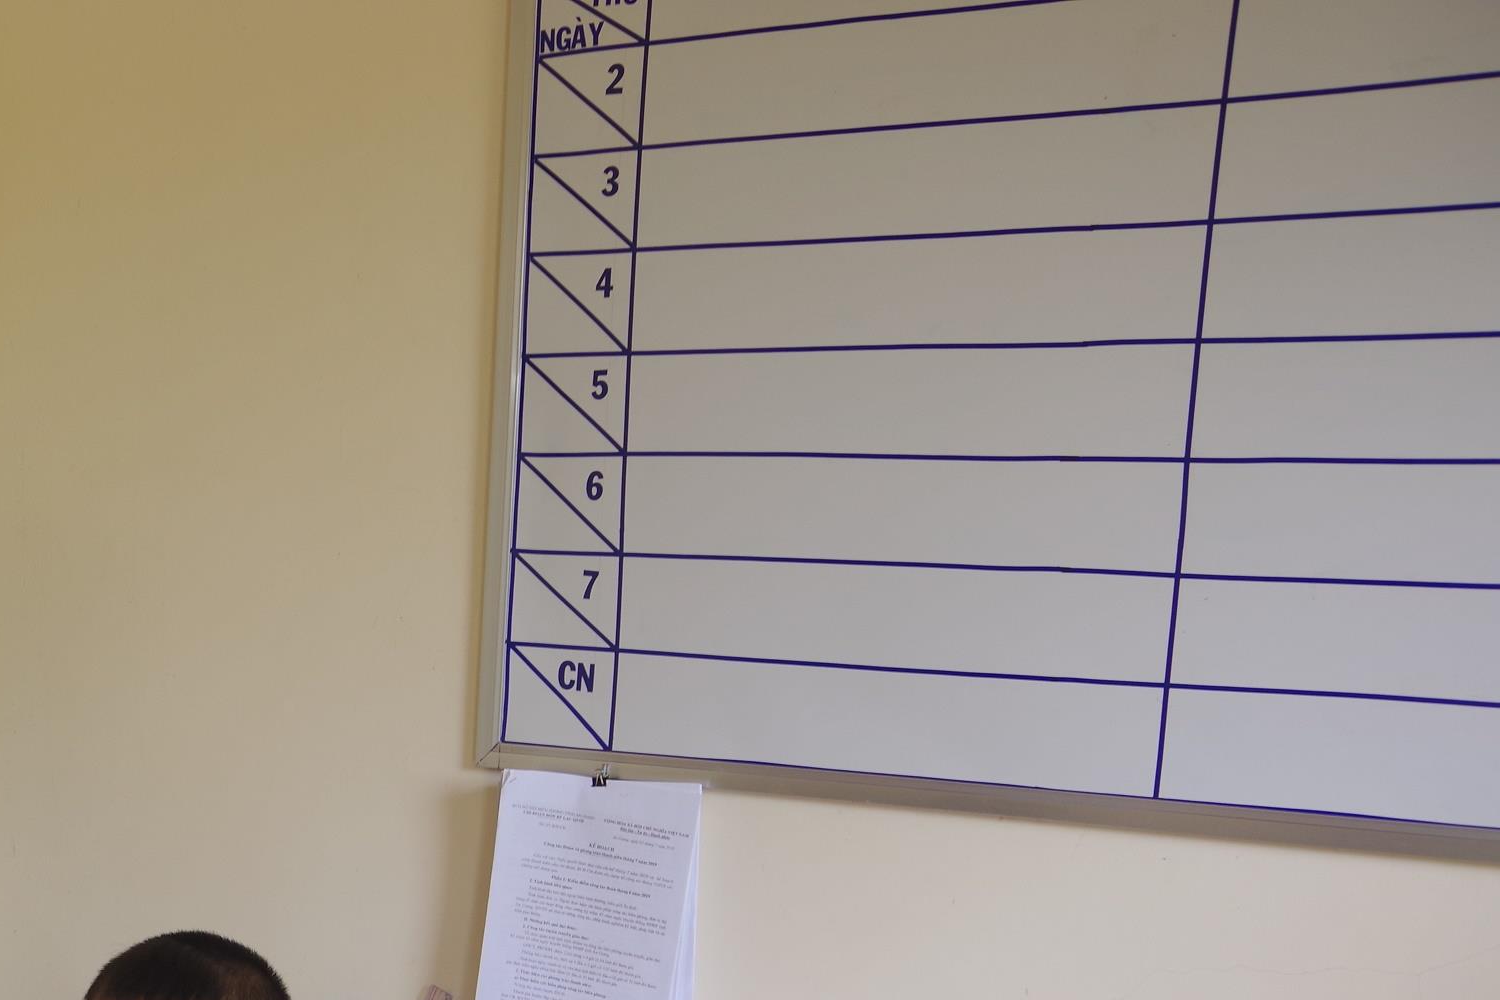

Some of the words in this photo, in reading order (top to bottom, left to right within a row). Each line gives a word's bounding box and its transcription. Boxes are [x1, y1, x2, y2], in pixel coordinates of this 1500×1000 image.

[540, 17, 604, 52] NGÀY
[605, 63, 625, 95] 2
[601, 166, 620, 197] 3
[595, 267, 614, 298] 4
[591, 370, 609, 400] 5
[586, 470, 604, 501] 6
[582, 570, 600, 600] 7
[558, 660, 596, 694] CN
